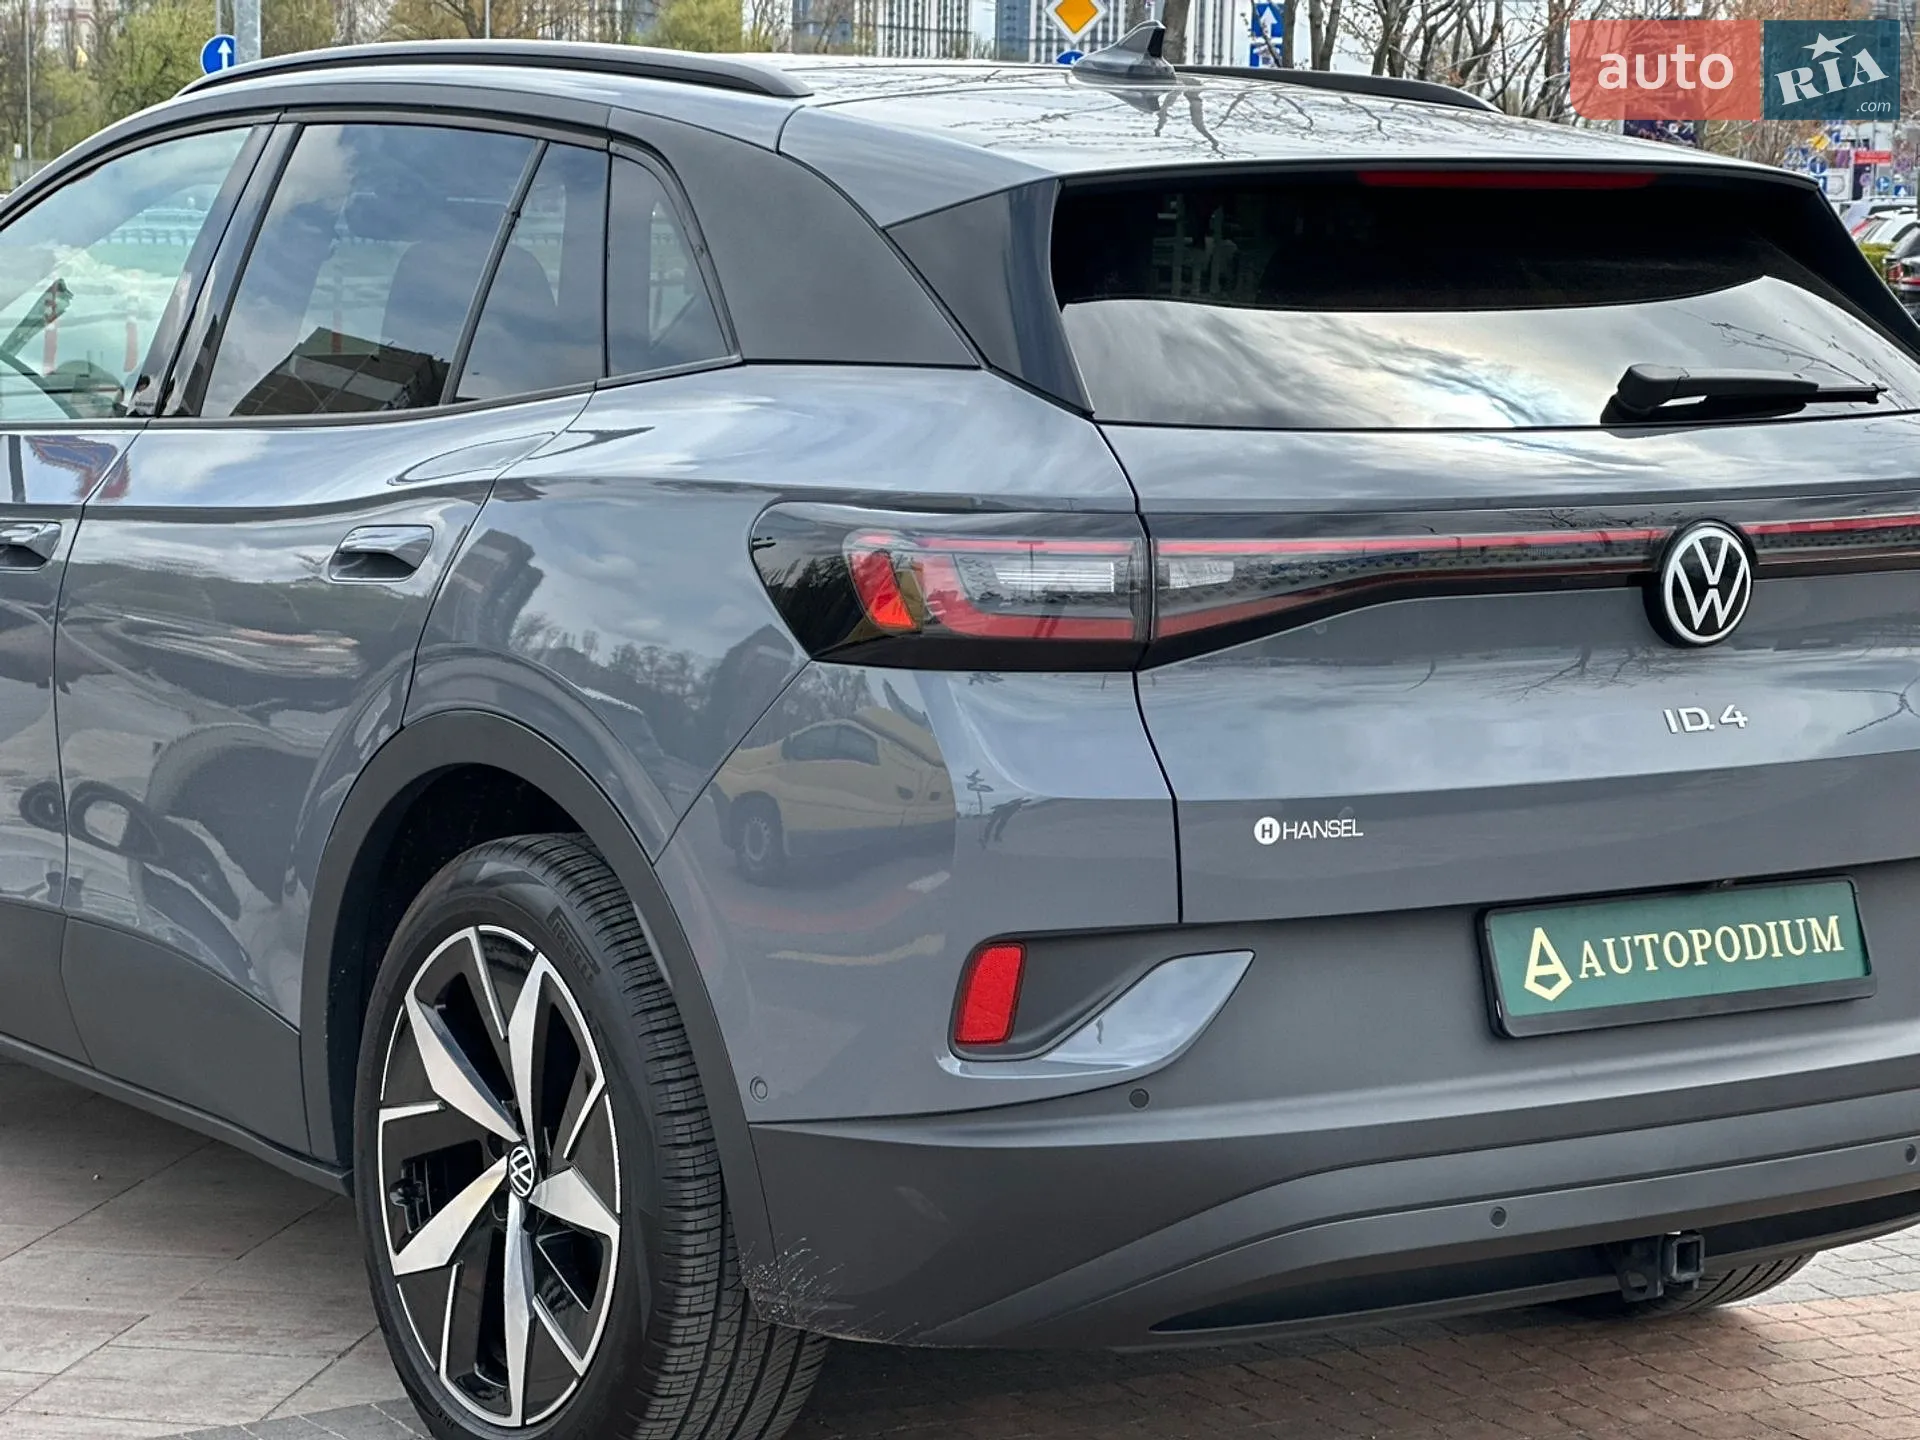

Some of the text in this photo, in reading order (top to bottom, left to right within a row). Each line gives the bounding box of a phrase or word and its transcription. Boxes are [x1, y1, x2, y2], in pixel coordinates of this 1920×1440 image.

[1663, 704, 1748, 734] ID.4
[1282, 819, 1364, 840] HANSEL
[1579, 915, 1845, 979] AUTOPODIUM
